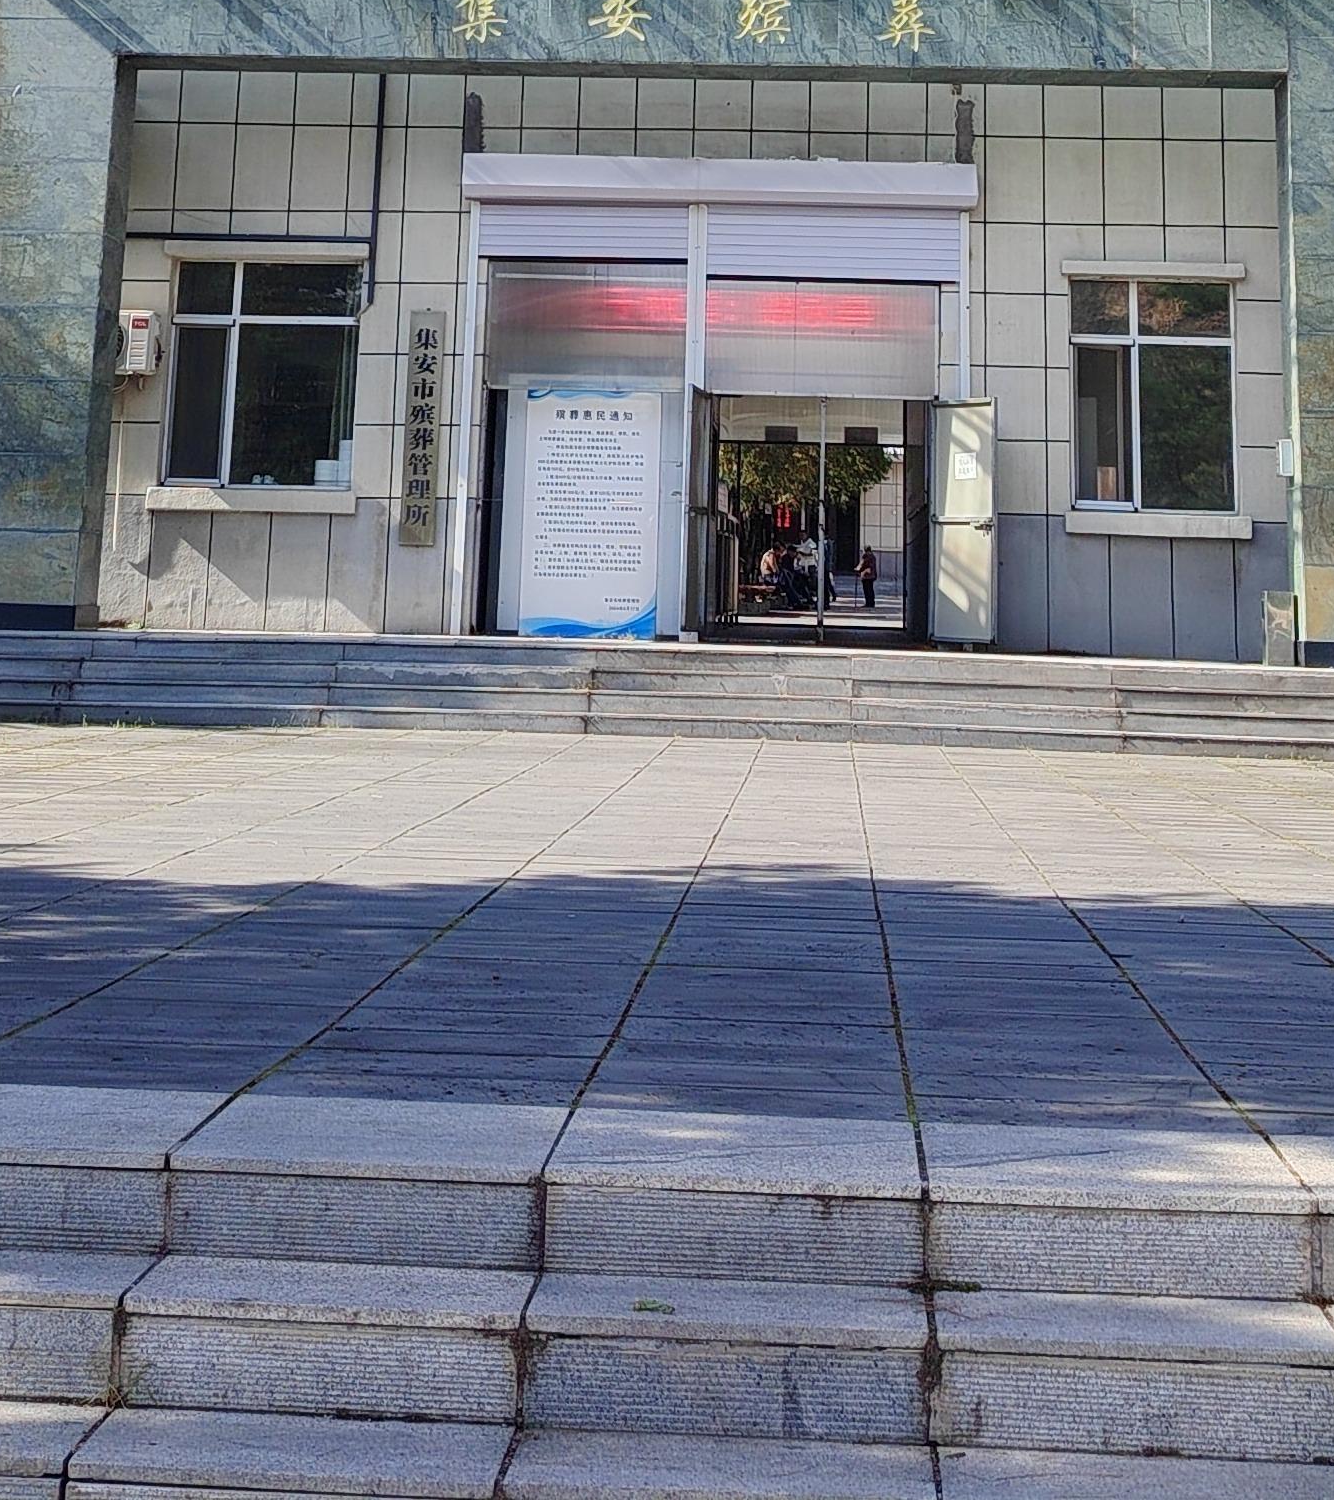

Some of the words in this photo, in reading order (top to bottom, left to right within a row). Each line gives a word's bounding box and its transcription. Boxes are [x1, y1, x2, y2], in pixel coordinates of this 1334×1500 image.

[403, 327, 439, 527] 集安市殡葬管理所
